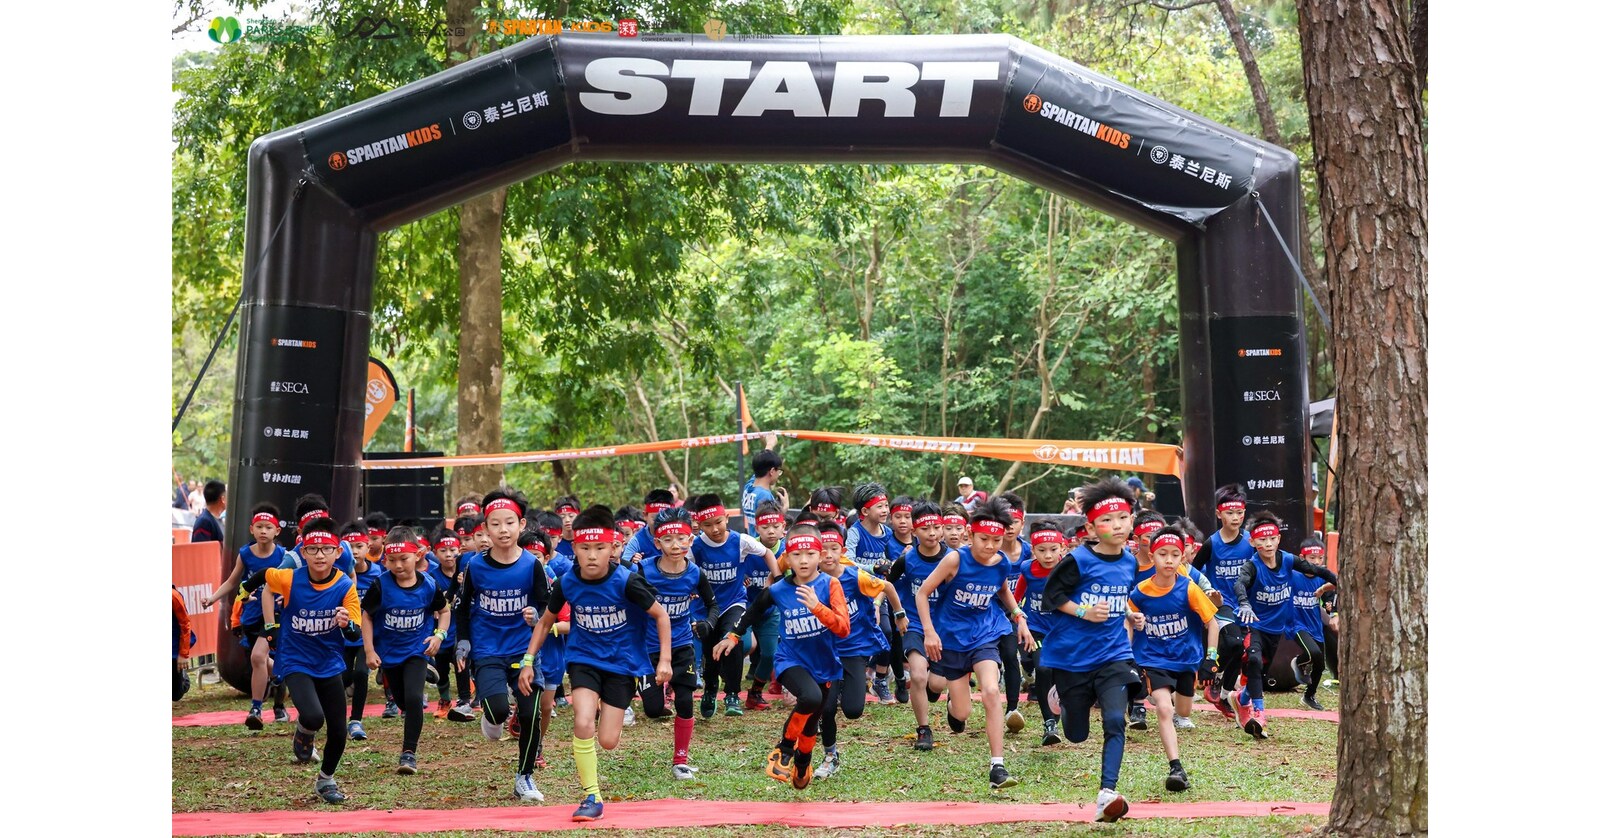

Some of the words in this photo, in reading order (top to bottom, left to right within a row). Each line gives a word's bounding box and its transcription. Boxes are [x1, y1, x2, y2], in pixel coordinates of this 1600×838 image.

[579, 57, 1000, 117] START
[346, 124, 442, 166] SPARTANKIDS
[483, 90, 550, 123] 泰兰尼斯
[1040, 102, 1130, 149] SPARTANKIDS
[1169, 154, 1232, 190] 泰兰尼斯
[278, 339, 316, 348] SPARTANKIDS
[281, 382, 309, 394] SECA
[1255, 390, 1281, 400] SECA
[274, 428, 308, 440] 泰兰尼斯
[1254, 436, 1284, 444] 泰兰尼斯
[272, 473, 302, 484] 补水啦
[1102, 498, 1126, 506] SPARTAN
[1215, 565, 1242, 576] SPART
[492, 588, 521, 597] 泰兰尼斯
[954, 589, 993, 606] SPART
[479, 593, 528, 612] SPARTAN
[575, 609, 627, 628] SPARTAN
[1152, 613, 1179, 622] 泰兰尼斯
[1145, 616, 1188, 636] SPARTAN
